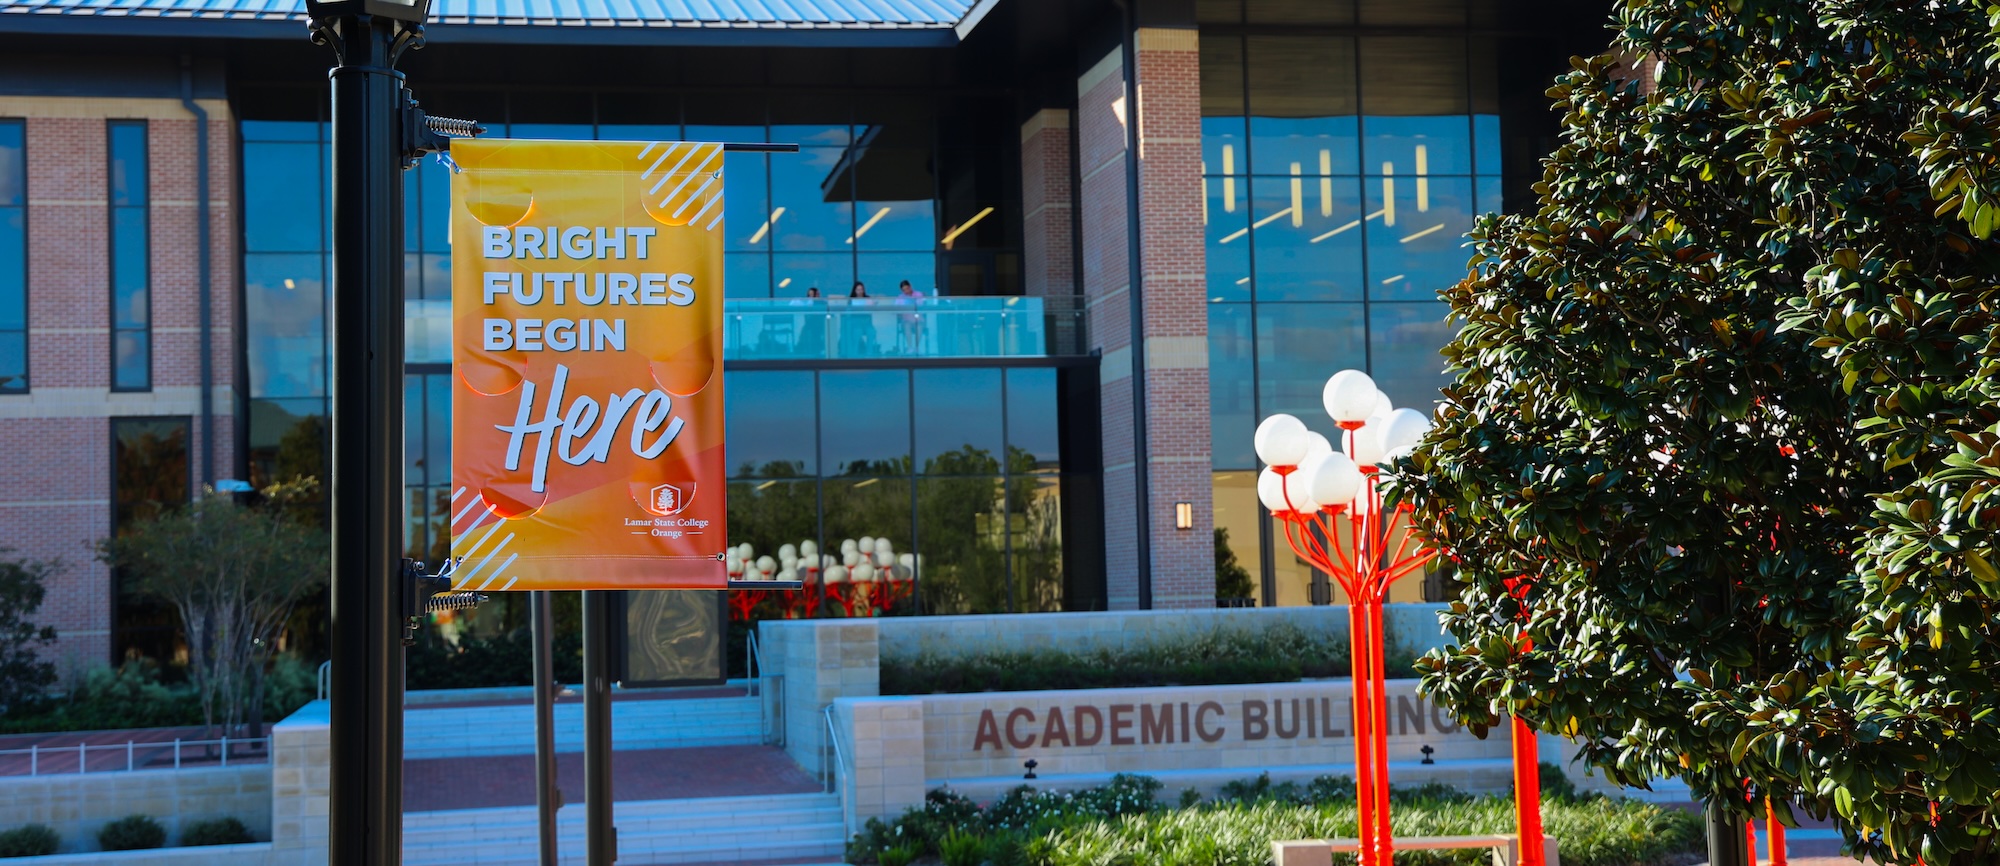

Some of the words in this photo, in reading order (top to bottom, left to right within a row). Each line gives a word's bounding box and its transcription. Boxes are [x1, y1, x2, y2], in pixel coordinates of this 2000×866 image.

[483, 225, 656, 260] BRIGHT
[483, 272, 695, 306] FUTURES
[483, 318, 626, 352] BEGIN
[494, 363, 684, 493] Here
[624, 518, 652, 526] Lamar
[654, 518, 675, 527] State
[677, 518, 709, 528] College
[651, 528, 682, 539] Orange
[973, 700, 1226, 751] ACADEMIC
